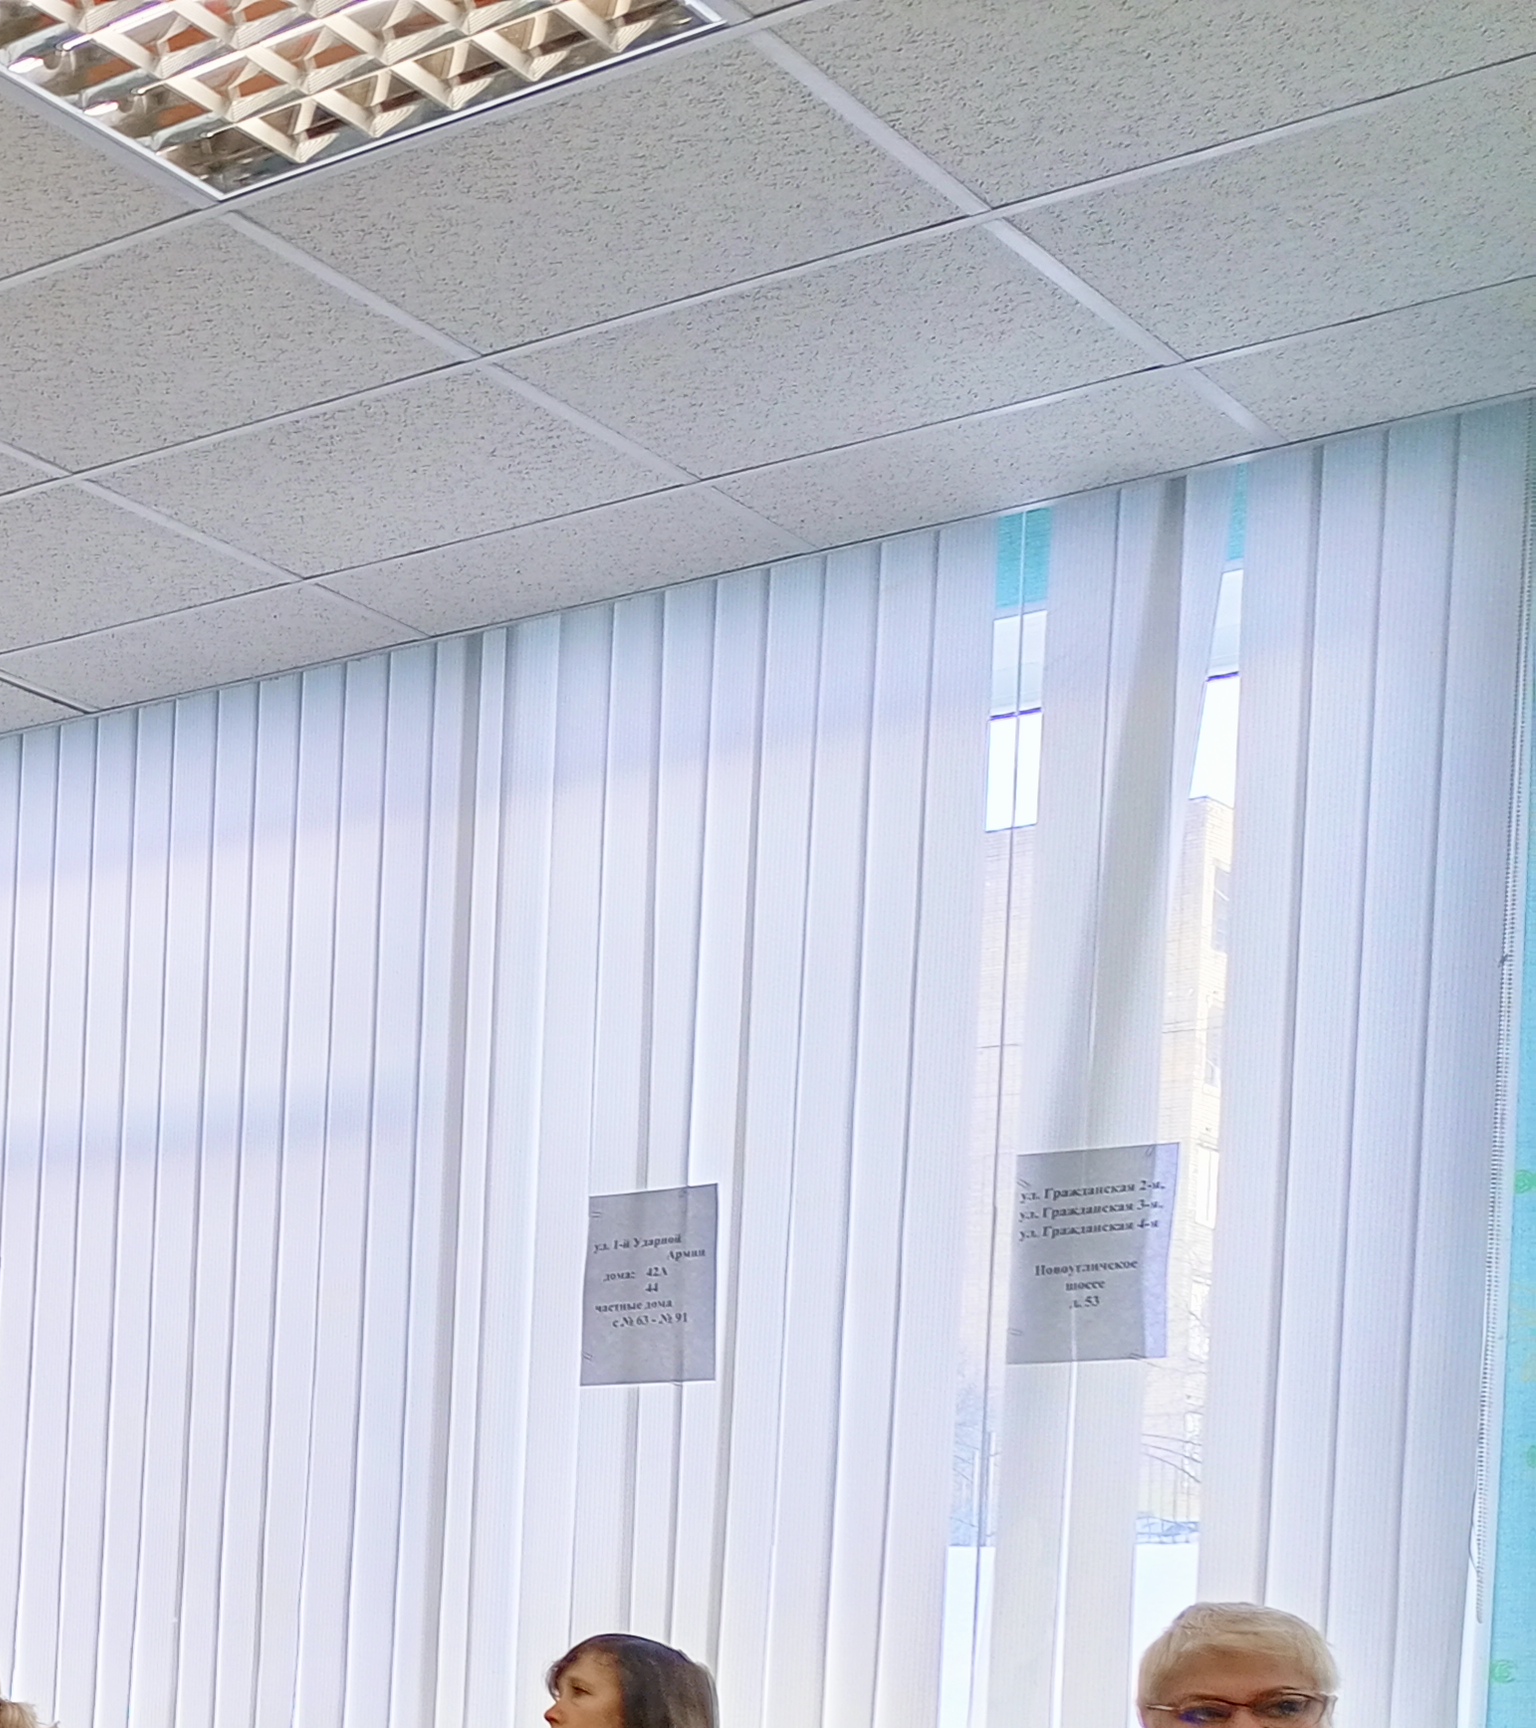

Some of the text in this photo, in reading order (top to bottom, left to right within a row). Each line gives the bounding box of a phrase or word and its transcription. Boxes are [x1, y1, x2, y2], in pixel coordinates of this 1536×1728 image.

[1044, 1183, 1135, 1201] Гражданская
[1042, 1202, 1133, 1220] Гражданская
[1042, 1221, 1134, 1239] Гражданская
[633, 1234, 682, 1249] Ударной
[667, 1249, 706, 1262] Армии
[1034, 1260, 1138, 1277] Новоугличское
[645, 1282, 659, 1293] 44
[1065, 1280, 1106, 1291] шоссе
[595, 1300, 672, 1313] частные дома
[1084, 1295, 1100, 1308] 53
[636, 1315, 649, 1326] 63
[675, 1312, 688, 1323] 91
